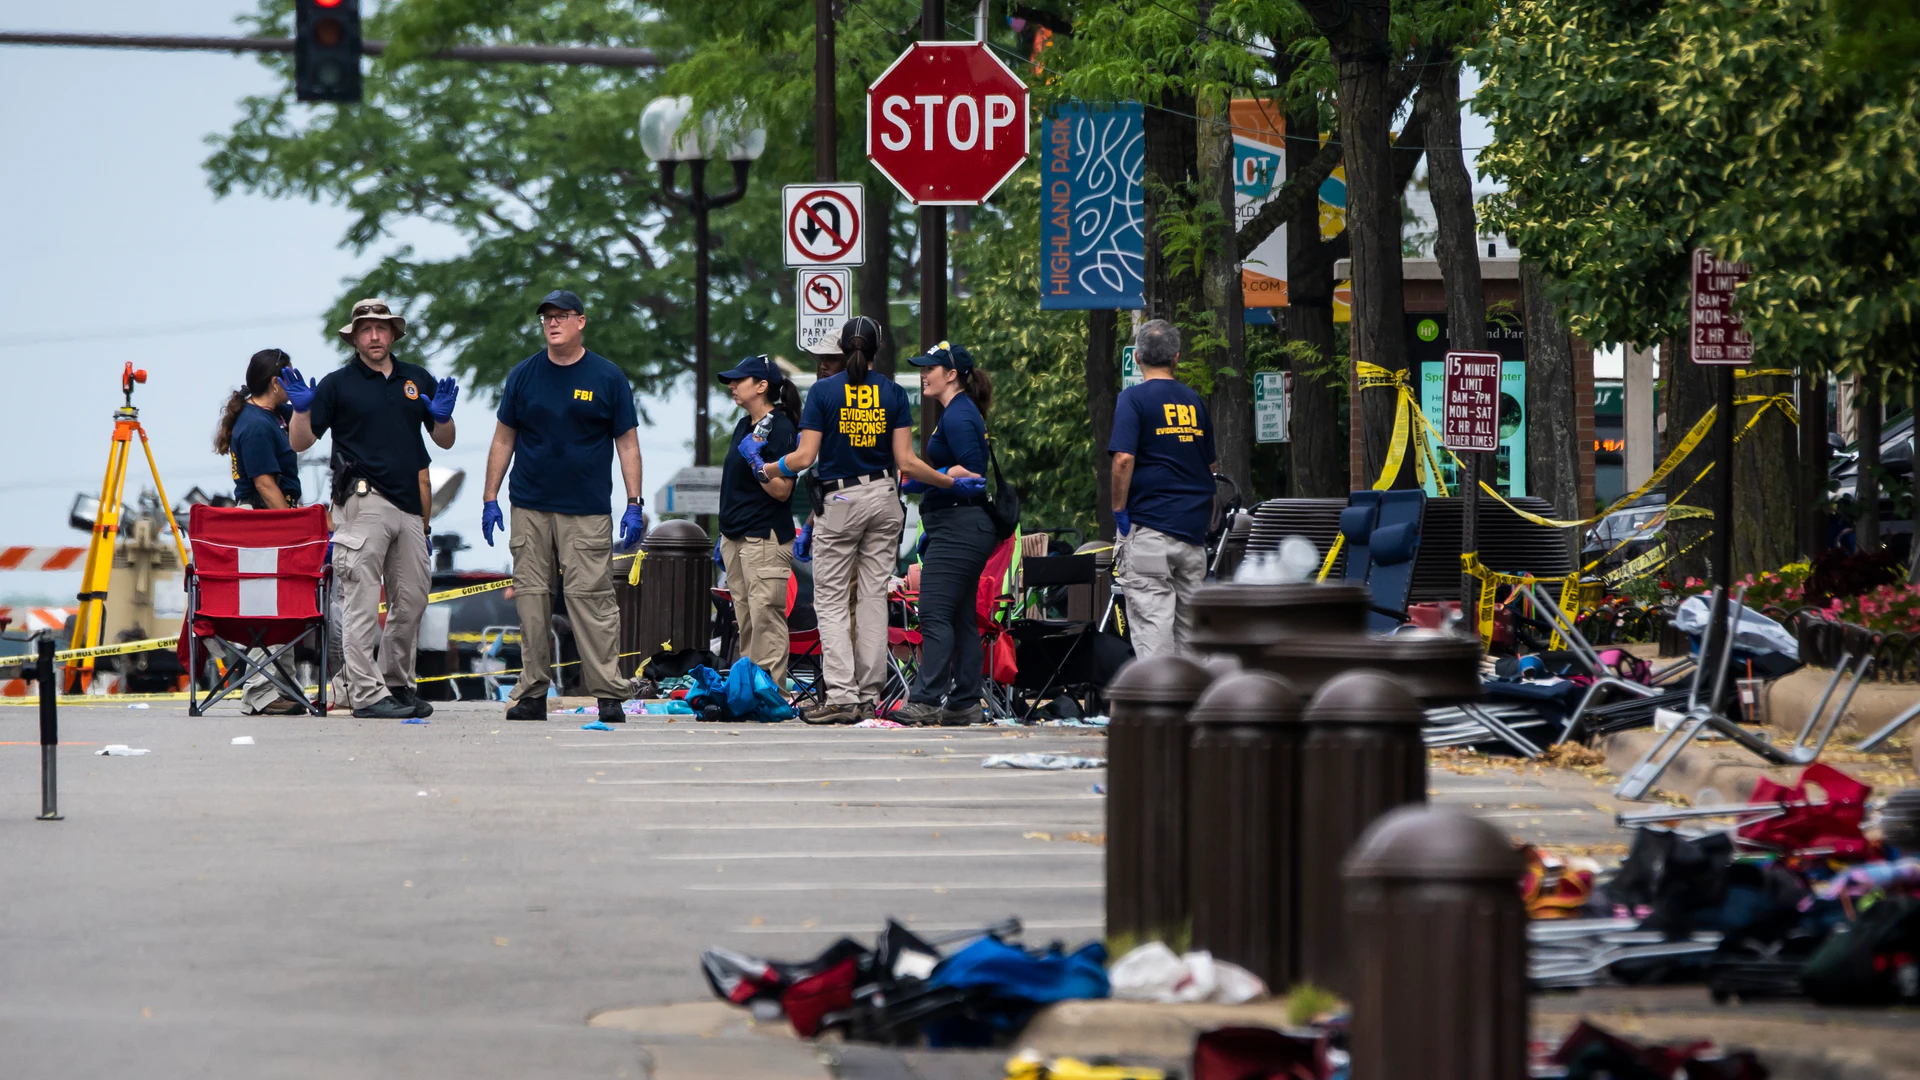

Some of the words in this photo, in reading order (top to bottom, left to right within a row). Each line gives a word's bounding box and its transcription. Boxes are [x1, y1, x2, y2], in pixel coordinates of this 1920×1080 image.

[880, 95, 1016, 151] STOP
[1051, 117, 1071, 172] PARK
[1051, 180, 1071, 295] HIGHLAND
[1697, 252, 1713, 274] 15
[1697, 292, 1737, 307] 8AM-7
[814, 317, 834, 327] INTO
[1695, 309, 1745, 324] MON-SA
[802, 327, 840, 337] PARK
[1504, 329, 1523, 338] Par
[1696, 328, 1704, 343] 2
[1708, 328, 1725, 343] HR
[1732, 329, 1750, 343] ALL
[1695, 345, 1724, 359] OTHER
[1726, 345, 1752, 359] TIMES
[1124, 352, 1132, 371] 2
[1449, 357, 1461, 376] 15
[1464, 363, 1496, 377] MINUTE
[1502, 373, 1522, 381] nter
[1256, 379, 1263, 396] 2
[1460, 378, 1483, 391] LIMIT
[574, 389, 593, 401] FBI
[844, 384, 879, 409] FBI
[1451, 390, 1491, 405] 8AM-7PM
[840, 408, 885, 421] EVIDENCE
[1163, 403, 1197, 427] FBI
[1449, 405, 1492, 419] MON-SAT
[839, 421, 887, 434] RESPONSE
[1448, 420, 1454, 433] 2
[1458, 420, 1470, 433] HR
[1475, 421, 1491, 434] ALL
[849, 434, 876, 447] TEAM
[1447, 434, 1470, 446] OTHER
[1471, 435, 1494, 447] TIMES
